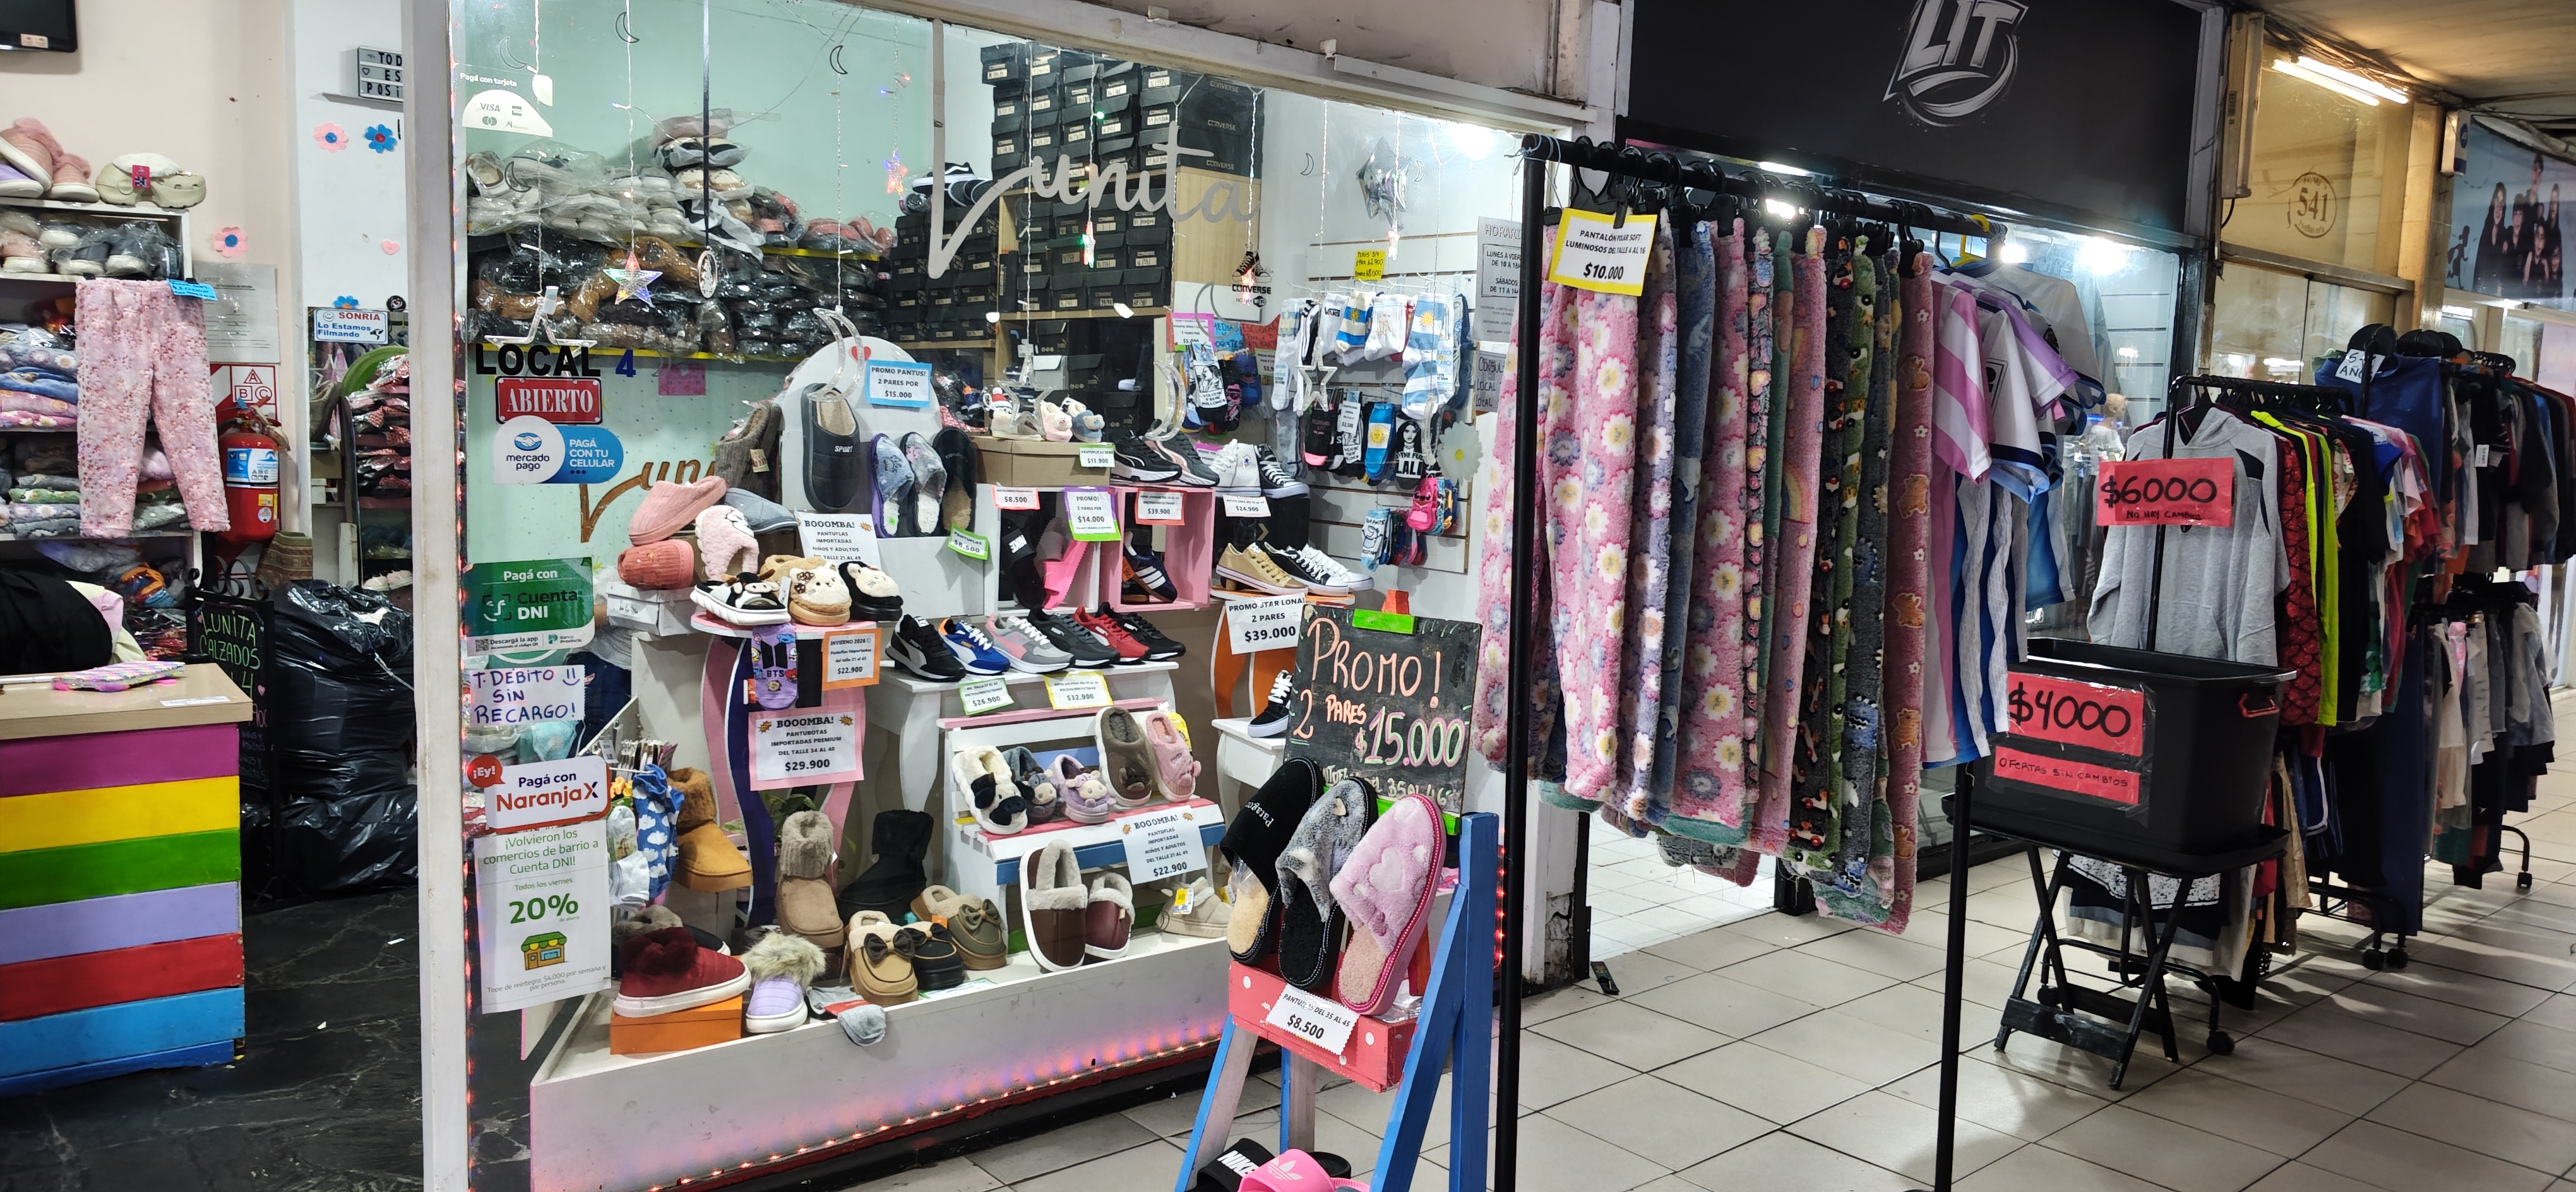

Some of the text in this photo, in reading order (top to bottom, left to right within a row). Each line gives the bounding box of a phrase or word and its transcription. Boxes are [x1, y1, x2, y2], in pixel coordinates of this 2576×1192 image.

[460, 72, 477, 83] Pagá
[494, 77, 517, 87] tarjeta
[480, 103, 501, 112] VISA
[1208, 119, 1236, 131] CONVERSE
[928, 18, 1261, 279] Lunita
[1207, 160, 1234, 170] CONVERSE
[2298, 187, 2328, 222] 541
[1580, 230, 1616, 241] PANTALÓN
[1565, 240, 1607, 253] LUMINOSOS
[1583, 262, 1624, 280] $10.000
[1232, 284, 1272, 294] CONVERSE
[338, 312, 381, 321] SONRIA
[332, 323, 371, 331] Estamos
[475, 343, 636, 378] LOCAL 4
[249, 372, 258, 382] A
[507, 388, 593, 413] ABIERTO
[569, 438, 597, 448] PAGÁ
[506, 454, 550, 462] mercado
[569, 450, 609, 458] CON TU
[516, 463, 540, 472] pago
[569, 459, 615, 468] CELULAR
[2101, 475, 2217, 510] $6000
[2144, 510, 2160, 520] HAY
[954, 531, 982, 545] PANTUFLAS
[1008, 535, 1027, 554] NIKE
[954, 540, 981, 553] $8.500
[503, 569, 558, 582] Pagá con
[517, 589, 578, 605] Cuenta
[518, 605, 549, 620] DNI
[1229, 603, 1257, 612] PROMO
[1260, 612, 1285, 621] PARES
[490, 637, 518, 645] Descargá
[1244, 626, 1296, 643] $39.000
[200, 635, 261, 670] CALZADOS
[766, 669, 785, 677] BTS
[837, 666, 863, 675] $22.900
[972, 695, 1001, 707] $26.900
[1066, 693, 1094, 701] $32.900
[474, 702, 575, 724] RECARGO!
[1293, 689, 1367, 739] 2 PARES
[2007, 681, 2132, 737] $4000
[776, 716, 835, 728] BOOOMBA!
[786, 729, 828, 737] PANTUBOTAS
[1354, 706, 1466, 767] $15.000
[771, 738, 813, 747] IMPORTADAS
[785, 758, 831, 772] $29.900
[473, 765, 496, 779] ¡Ey!
[518, 773, 576, 788] Pagá con
[1134, 814, 1179, 830] BOOOMBA!
[1148, 827, 1175, 837] PANTUFLAS
[1148, 833, 1179, 844] IMPORTADAS
[505, 829, 578, 850] ¡Volvieron los
[1165, 841, 1186, 850] ADULTOS
[483, 849, 540, 865] comercios
[542, 846, 556, 857] de
[559, 842, 590, 854] barrio
[510, 855, 576, 874] Cuenta DNI!
[1153, 862, 1188, 877] $22.900
[509, 893, 578, 924] 20%
[578, 967, 601, 975] semana
[1314, 1006, 1325, 1016] DEL
[1325, 1011, 1333, 1020] 35
[1333, 1016, 1342, 1024] AL
[1287, 1013, 1325, 1039] $8.500
